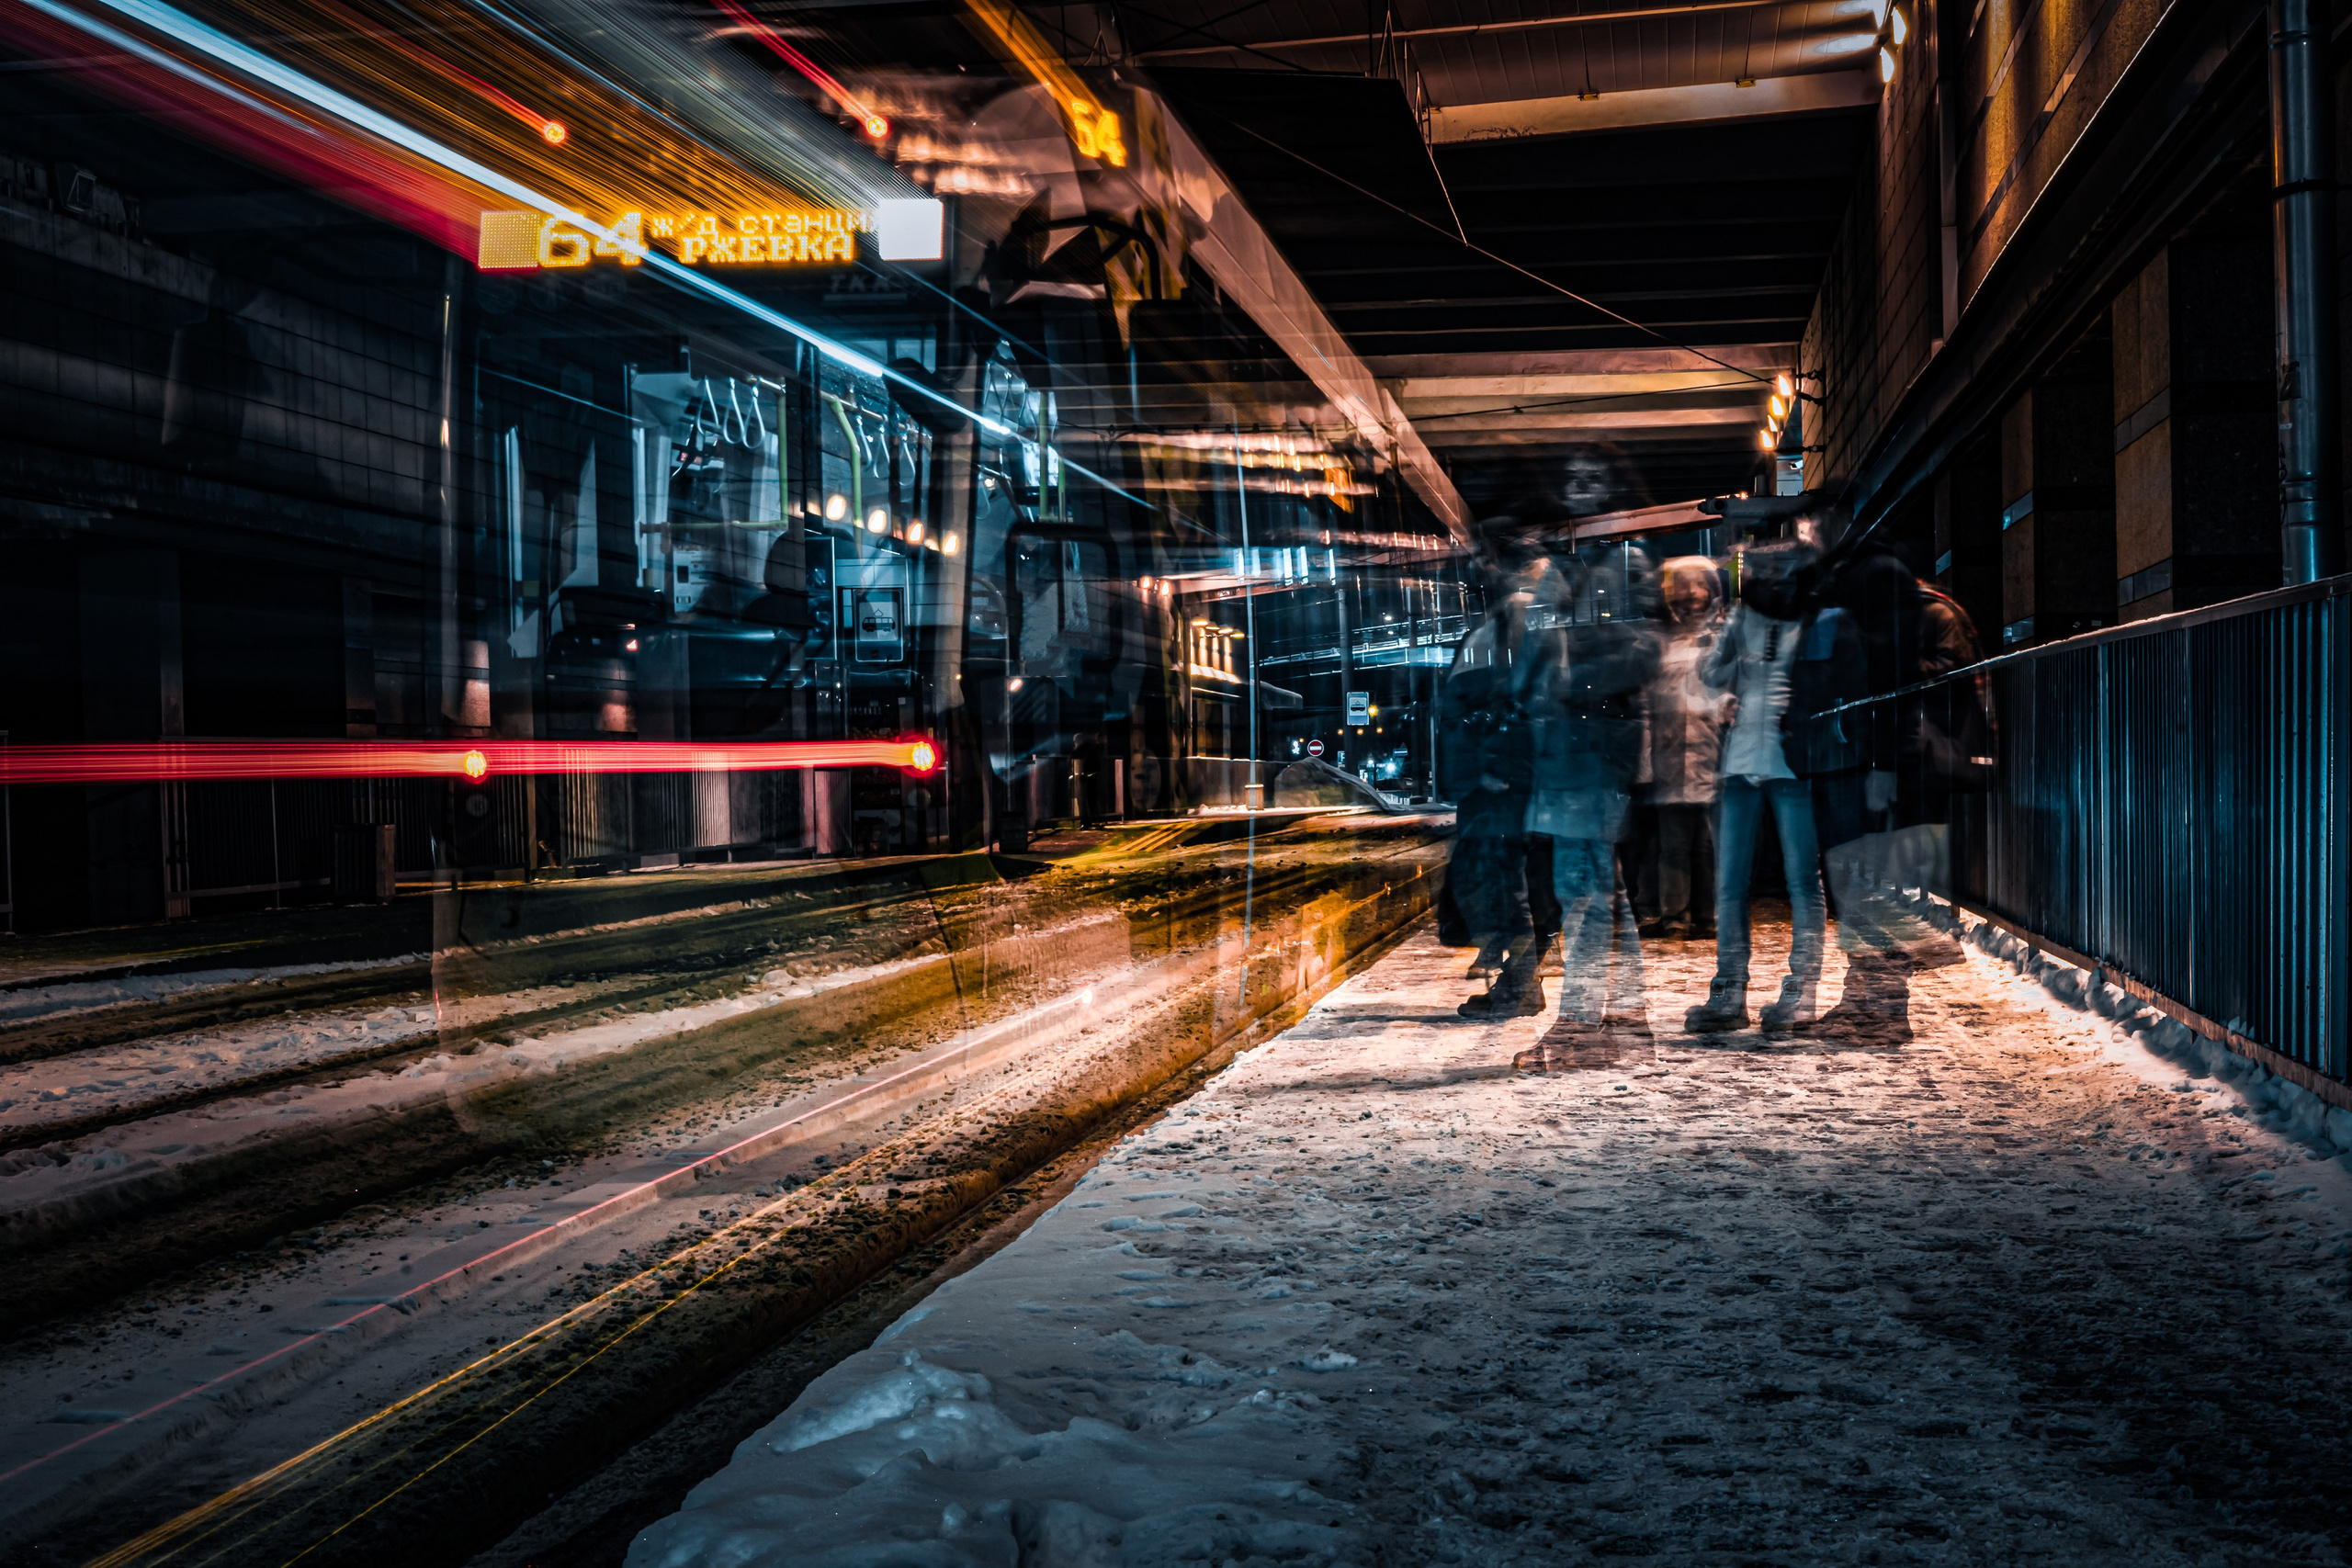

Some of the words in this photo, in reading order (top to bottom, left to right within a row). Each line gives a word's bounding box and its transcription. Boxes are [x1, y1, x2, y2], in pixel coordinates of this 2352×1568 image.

[1071, 100, 1127, 167] 64
[537, 210, 644, 267] 64
[681, 235, 853, 264] РЖЕВКА
